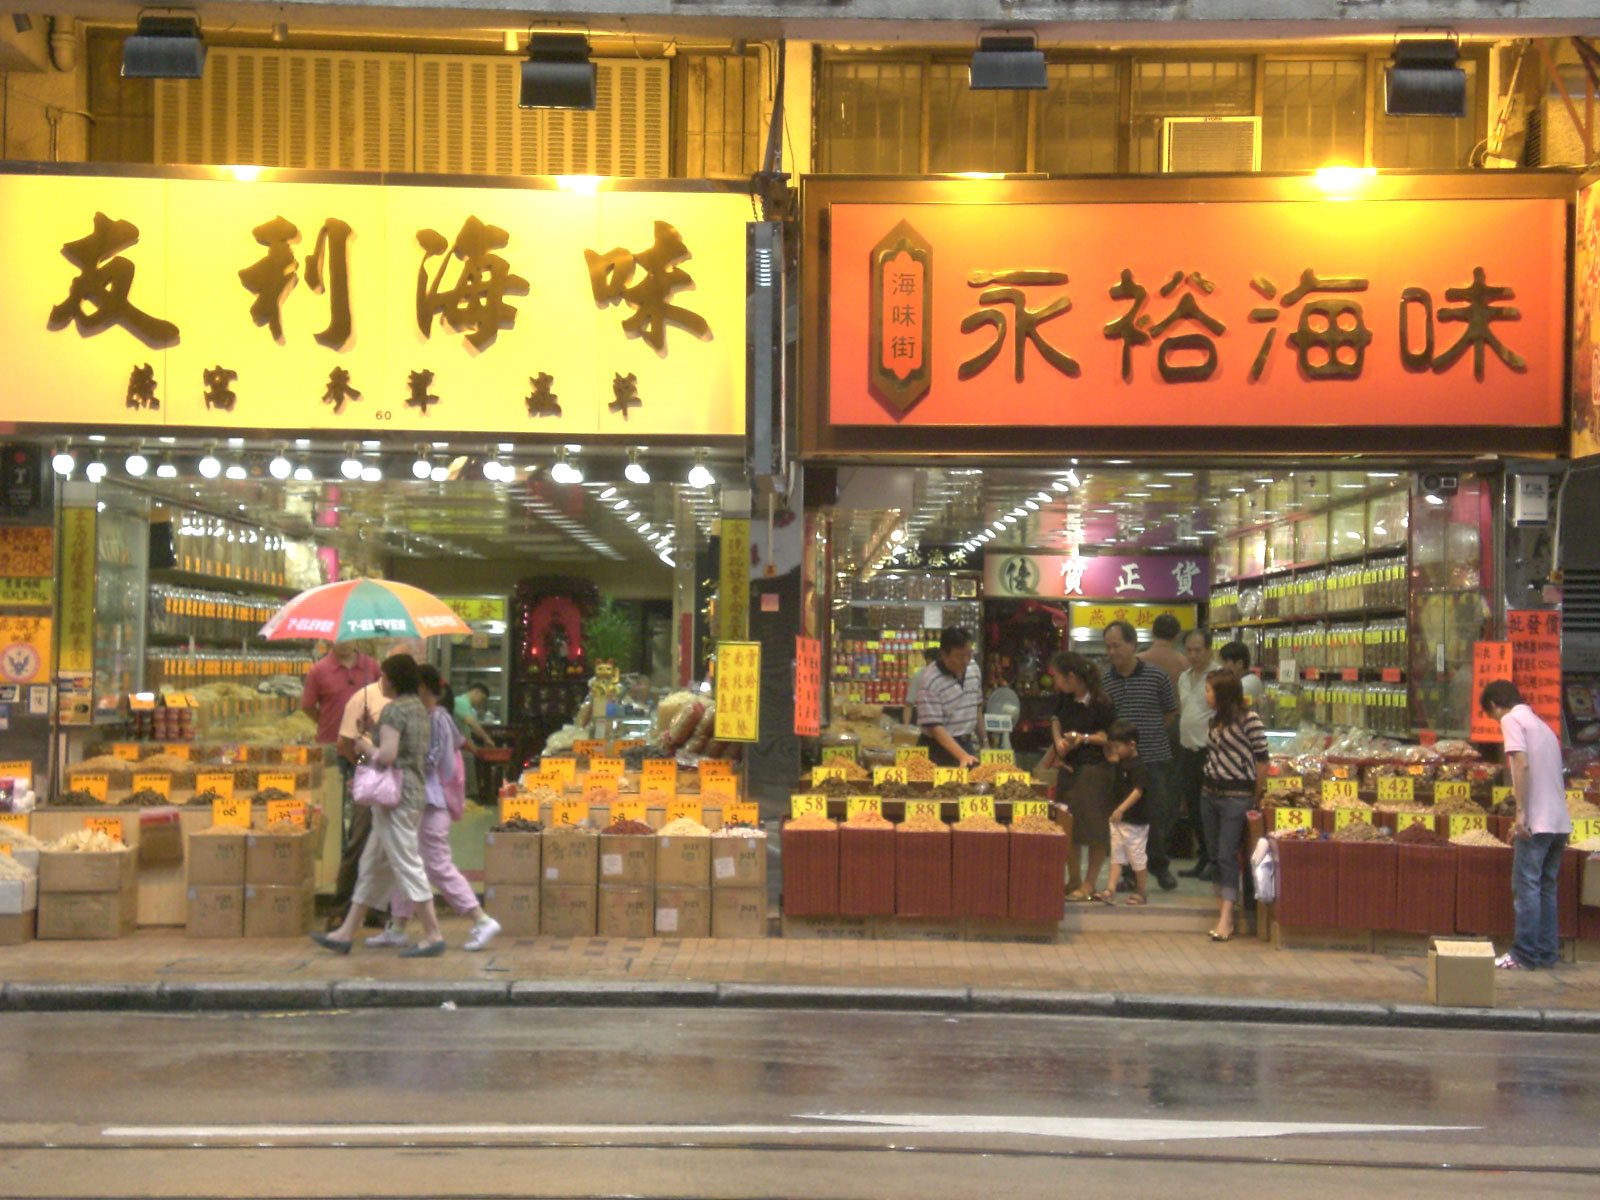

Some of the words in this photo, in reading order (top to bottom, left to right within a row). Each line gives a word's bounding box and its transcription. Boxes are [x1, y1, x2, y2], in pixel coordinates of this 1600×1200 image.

[47, 211, 714, 357] 友利海味
[891, 272, 917, 360] 海味街
[957, 267, 1527, 384] 永裕海味
[375, 411, 392, 421] 60
[989, 752, 1012, 764] 188
[1387, 778, 1409, 793] 42
[804, 797, 824, 811] 58
[858, 799, 878, 812] 78
[969, 798, 988, 812] 68
[1023, 803, 1047, 816] 148
[1288, 810, 1303, 825] 8
[1461, 816, 1483, 830] 28
